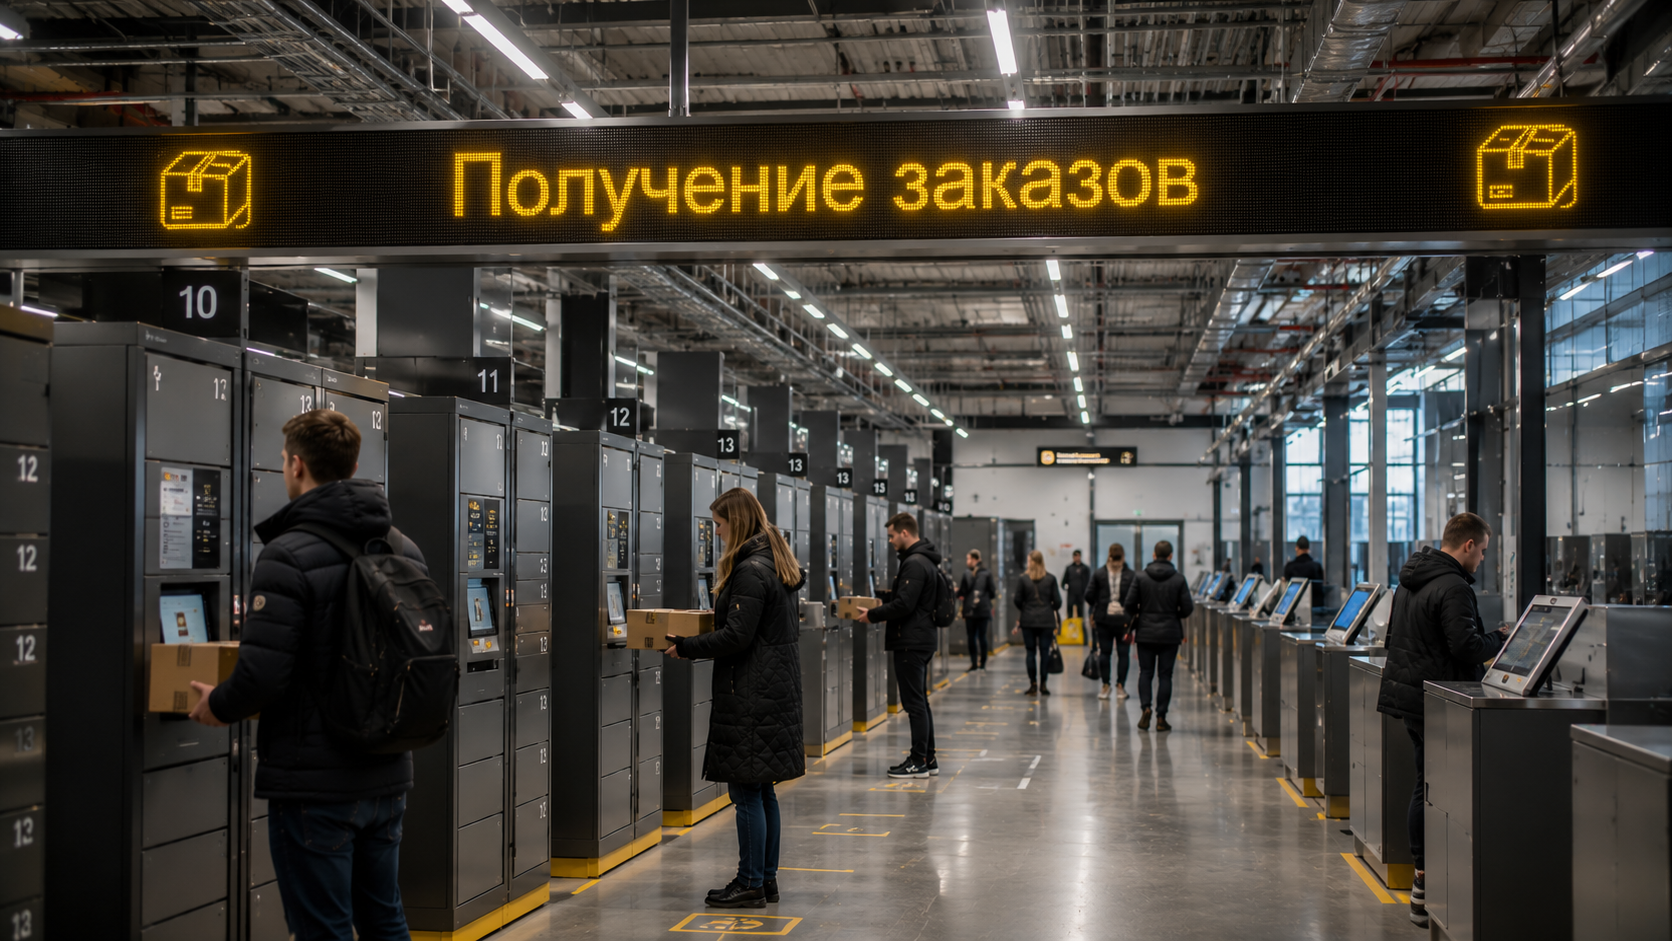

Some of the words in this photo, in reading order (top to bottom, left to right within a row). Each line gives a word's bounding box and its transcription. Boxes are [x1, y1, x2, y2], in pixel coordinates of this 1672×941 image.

[452, 150, 865, 232] Получение
[892, 157, 1200, 211] заказов
[179, 285, 217, 319] 10
[477, 368, 498, 393] 11
[610, 407, 630, 427] 12
[717, 436, 736, 453] 13
[17, 455, 39, 483] 12
[788, 458, 803, 472] 13
[837, 472, 849, 484] 13
[17, 545, 37, 572] 12
[16, 634, 36, 662] 12
[14, 725, 35, 753] 13
